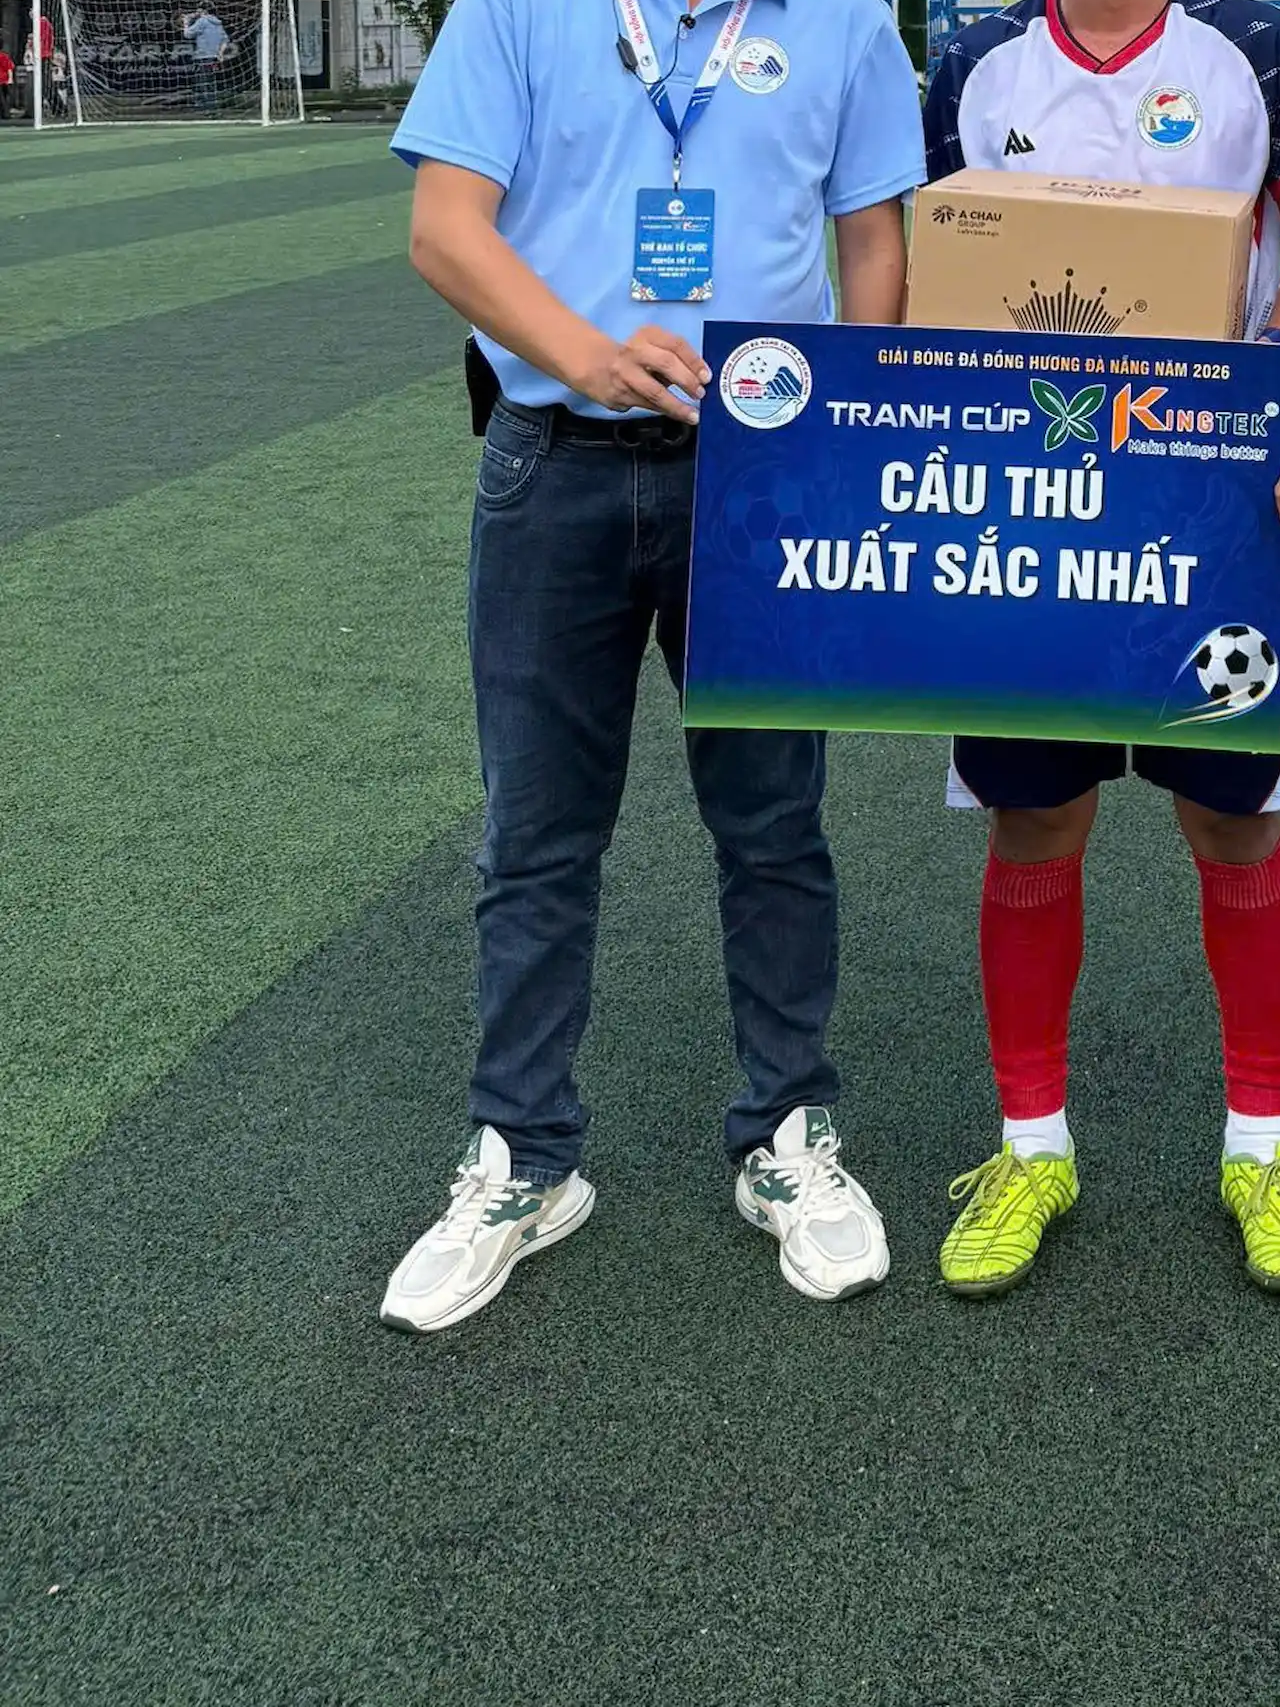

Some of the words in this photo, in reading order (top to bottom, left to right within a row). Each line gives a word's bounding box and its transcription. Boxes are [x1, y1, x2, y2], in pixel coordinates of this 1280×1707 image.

[959, 210, 968, 219] A
[970, 211, 1002, 222] CHAU
[878, 345, 908, 365] GIẢI
[912, 347, 954, 367] BÓNG
[958, 349, 979, 368] ĐÁ
[983, 349, 1024, 370] ĐỒNG
[1029, 353, 1080, 372] HƯƠNG
[1084, 354, 1106, 374] ĐÀ
[1109, 354, 1150, 375] NẴNG
[1154, 358, 1188, 377] NĂM
[1192, 363, 1231, 380] 2026
[826, 401, 951, 430] TRANH
[961, 402, 1031, 433] CÚP
[1111, 382, 1269, 453] KINGTEK
[1127, 439, 1168, 456] Make
[1169, 440, 1218, 460] things
[1220, 444, 1269, 461] better
[880, 445, 988, 515] CẦU
[1004, 452, 1104, 521] THỦ
[776, 523, 918, 593] XUẤT
[932, 525, 1040, 598] SẮC
[1057, 535, 1199, 607] NHẤT
